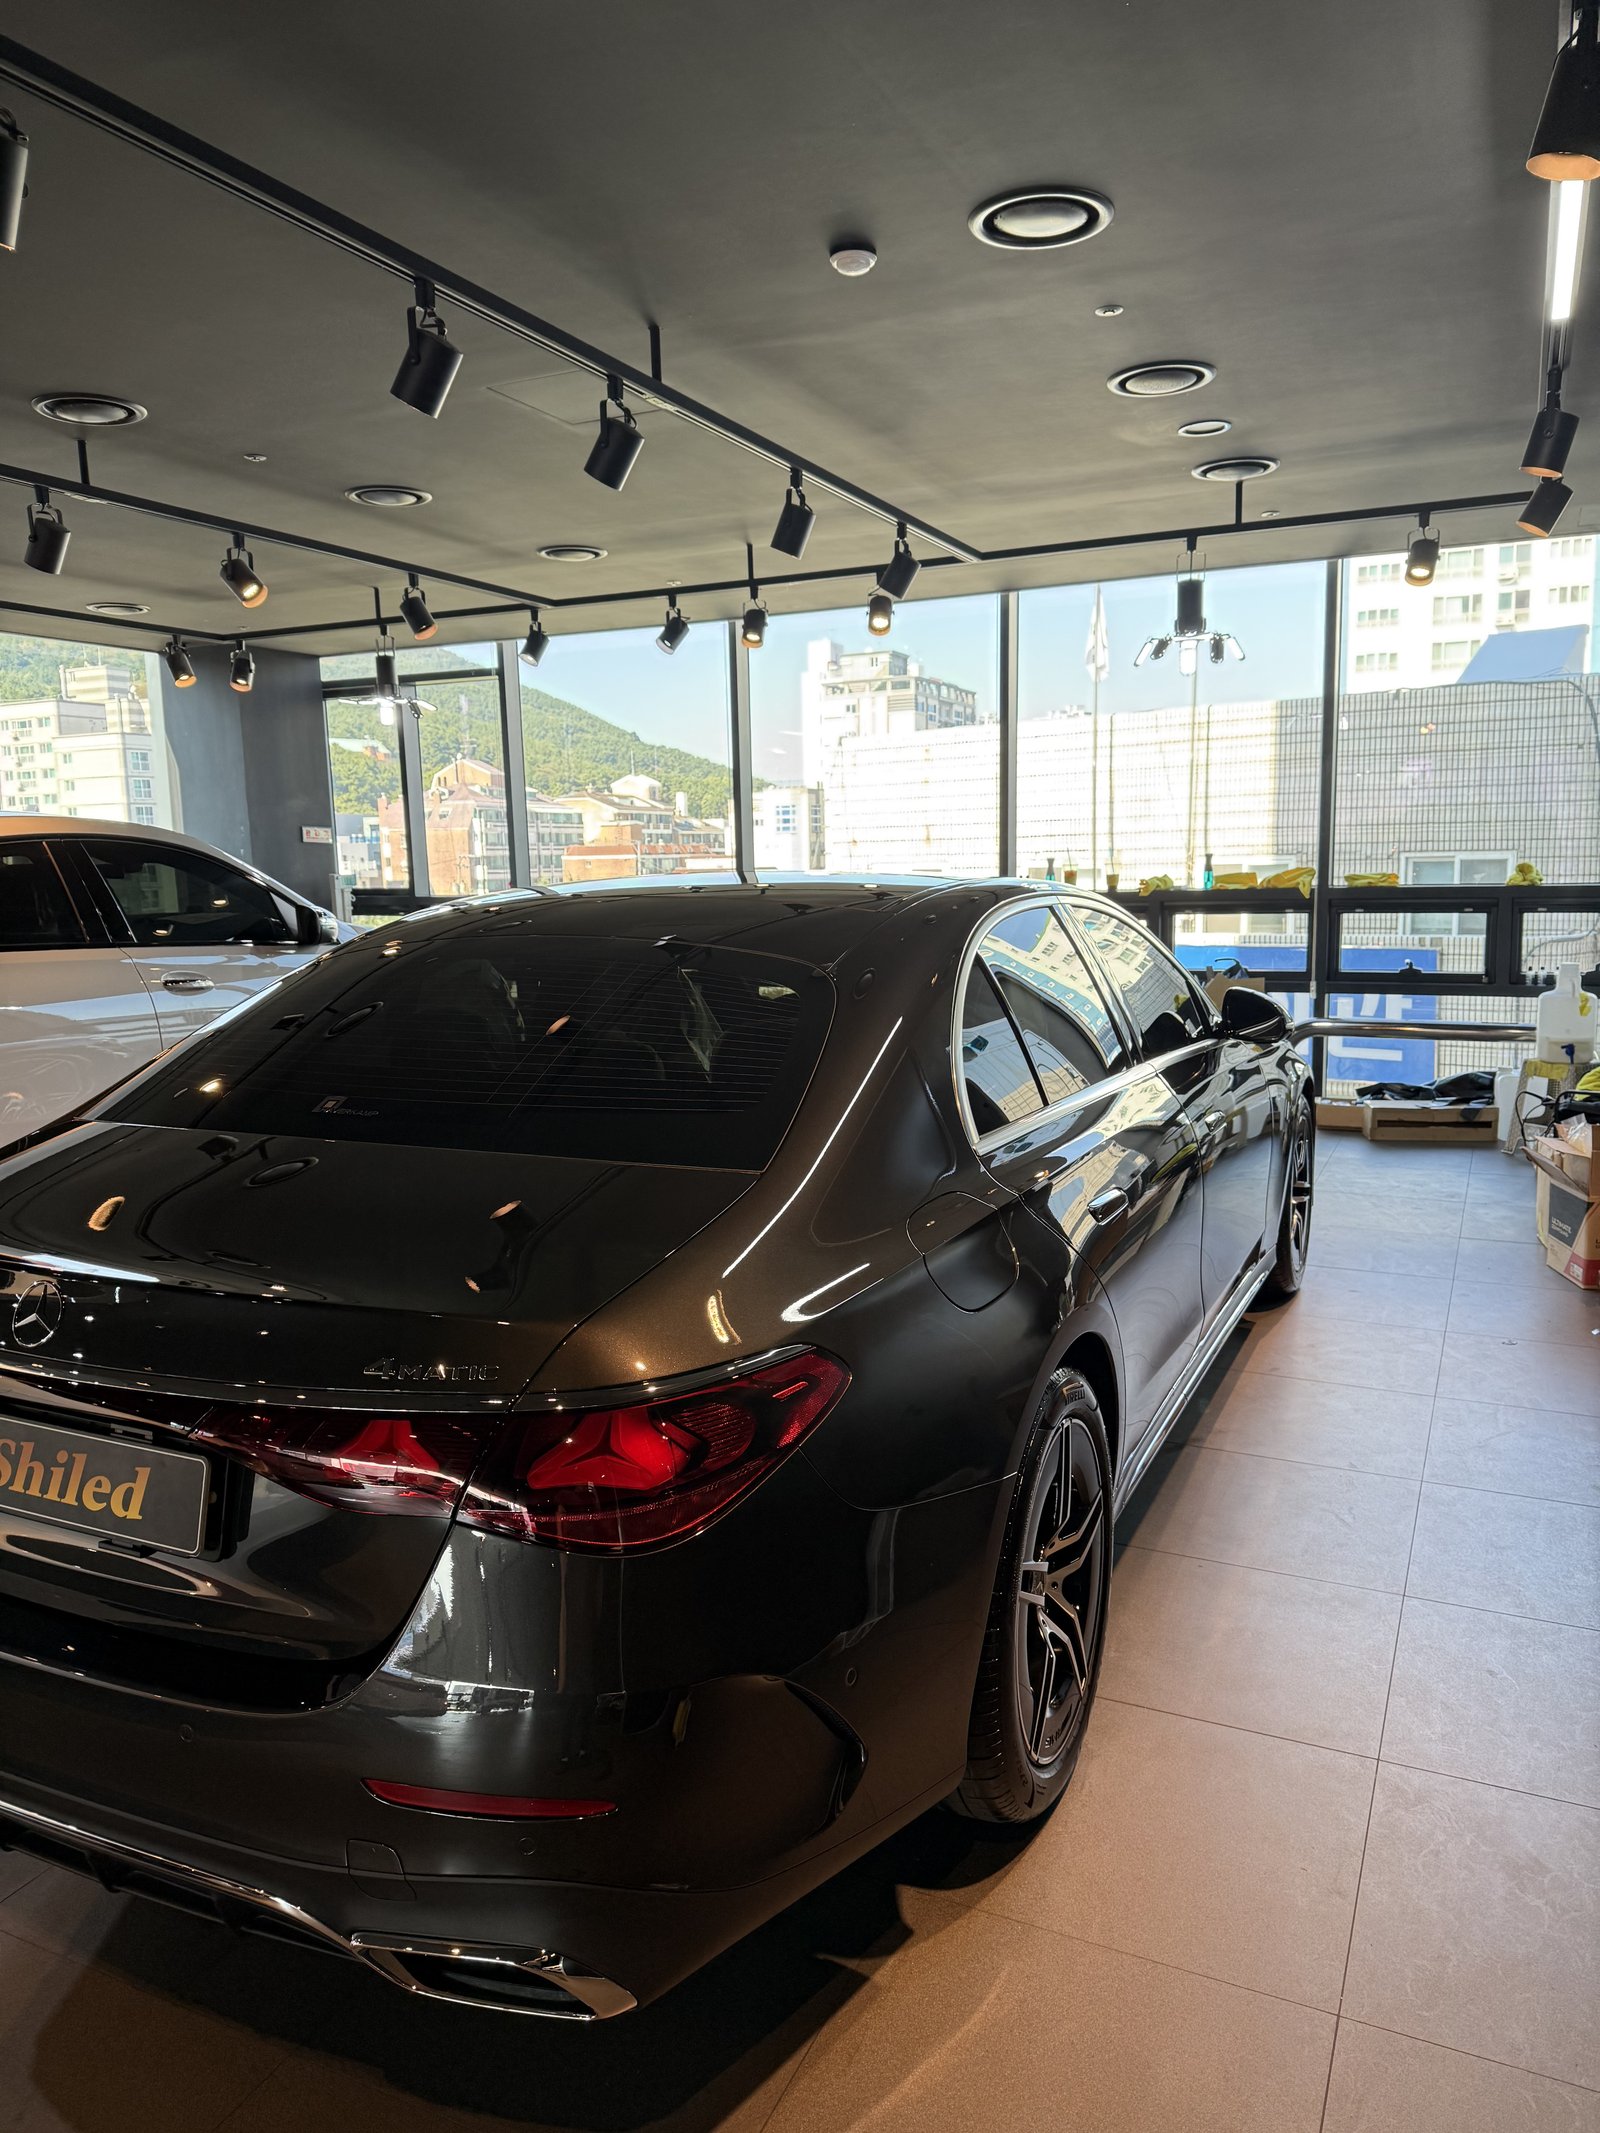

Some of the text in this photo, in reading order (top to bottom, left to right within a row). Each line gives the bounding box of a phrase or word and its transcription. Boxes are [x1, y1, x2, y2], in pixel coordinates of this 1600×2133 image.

[363, 1357, 500, 1381] 4MATIC
[1062, 1381, 1086, 1406] PIRELLI
[0, 1438, 152, 1520] Shiled
